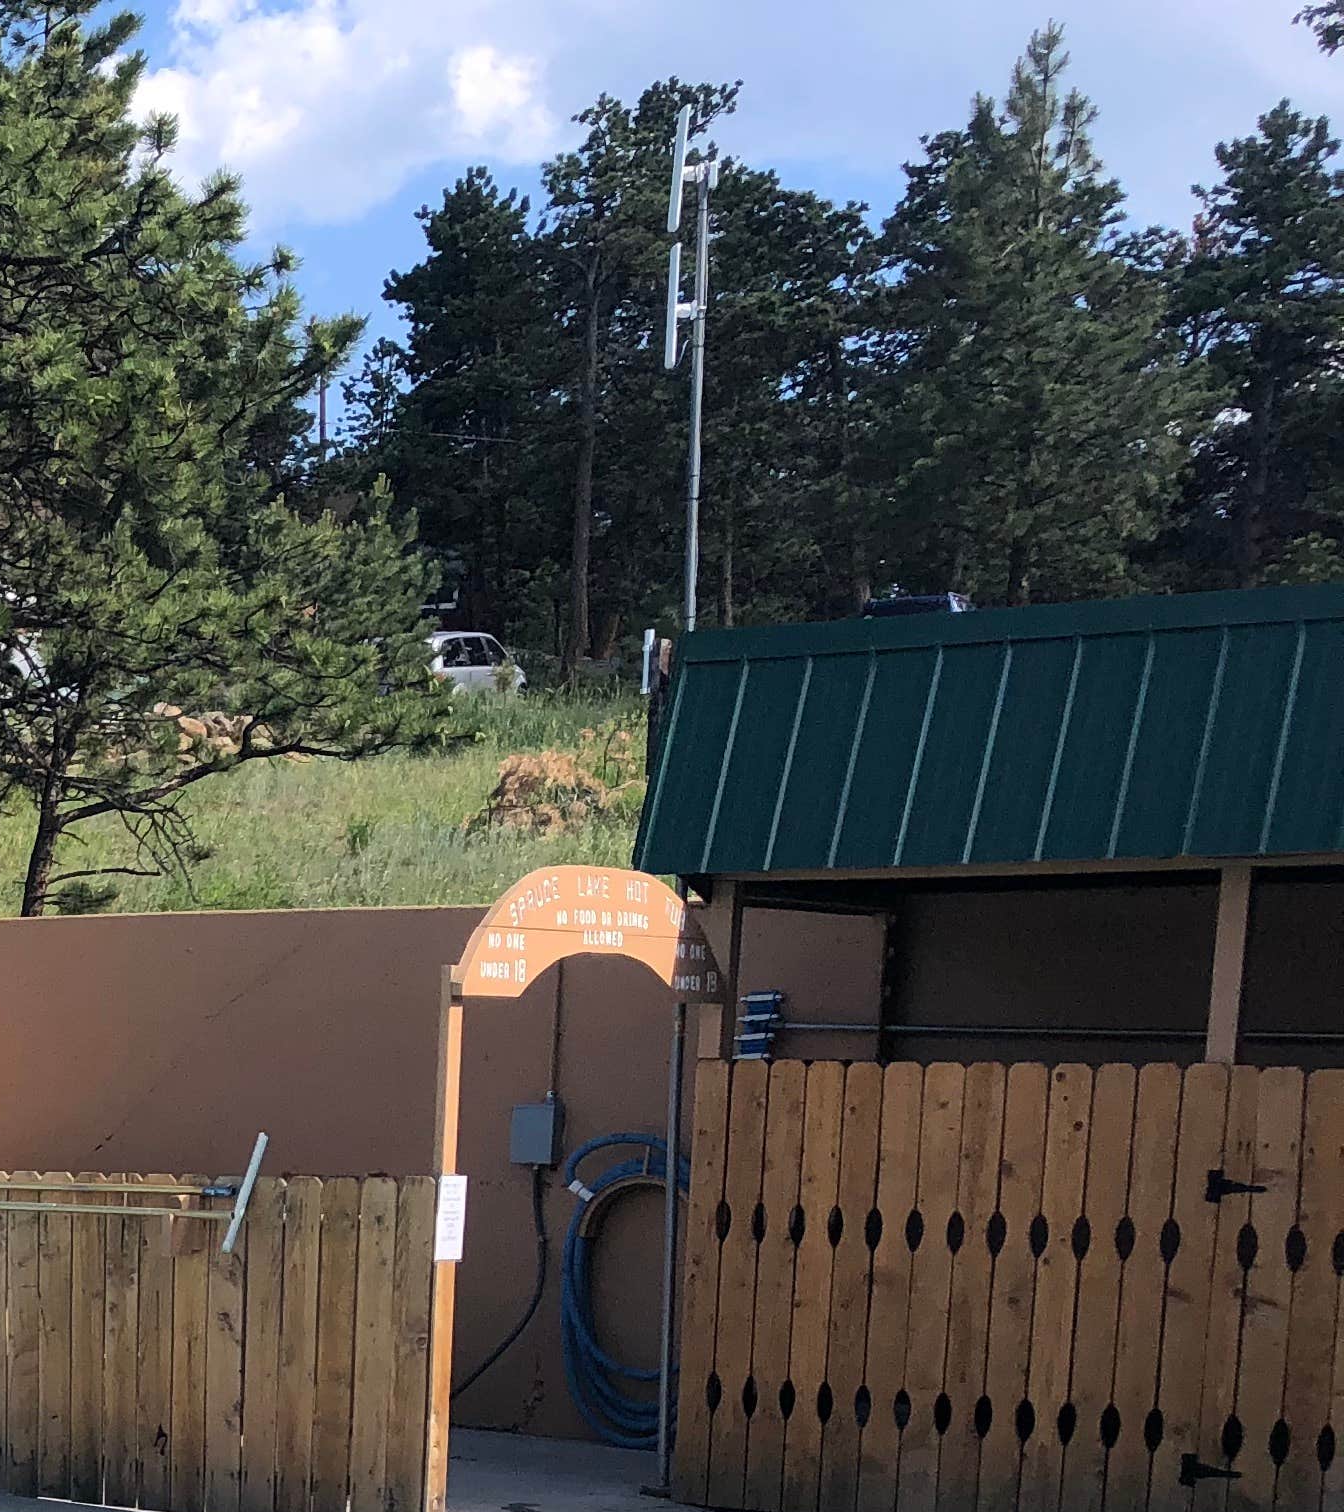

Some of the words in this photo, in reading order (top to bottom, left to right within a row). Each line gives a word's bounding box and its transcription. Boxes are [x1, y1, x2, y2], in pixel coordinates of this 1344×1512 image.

[509, 875, 561, 927] SPRUCE
[577, 873, 610, 899] LAKE
[625, 879, 650, 904] HOT
[556, 909, 568, 926] NO
[573, 908, 597, 925] FOOD
[601, 910, 612, 926] OR
[617, 910, 649, 930] DRINKS
[488, 932, 502, 949] NO
[506, 932, 525, 951] ONE
[583, 930, 624, 947] ALLOWED
[689, 943, 706, 960] ONE
[480, 960, 510, 979] UNDER
[514, 958, 527, 983] 18
